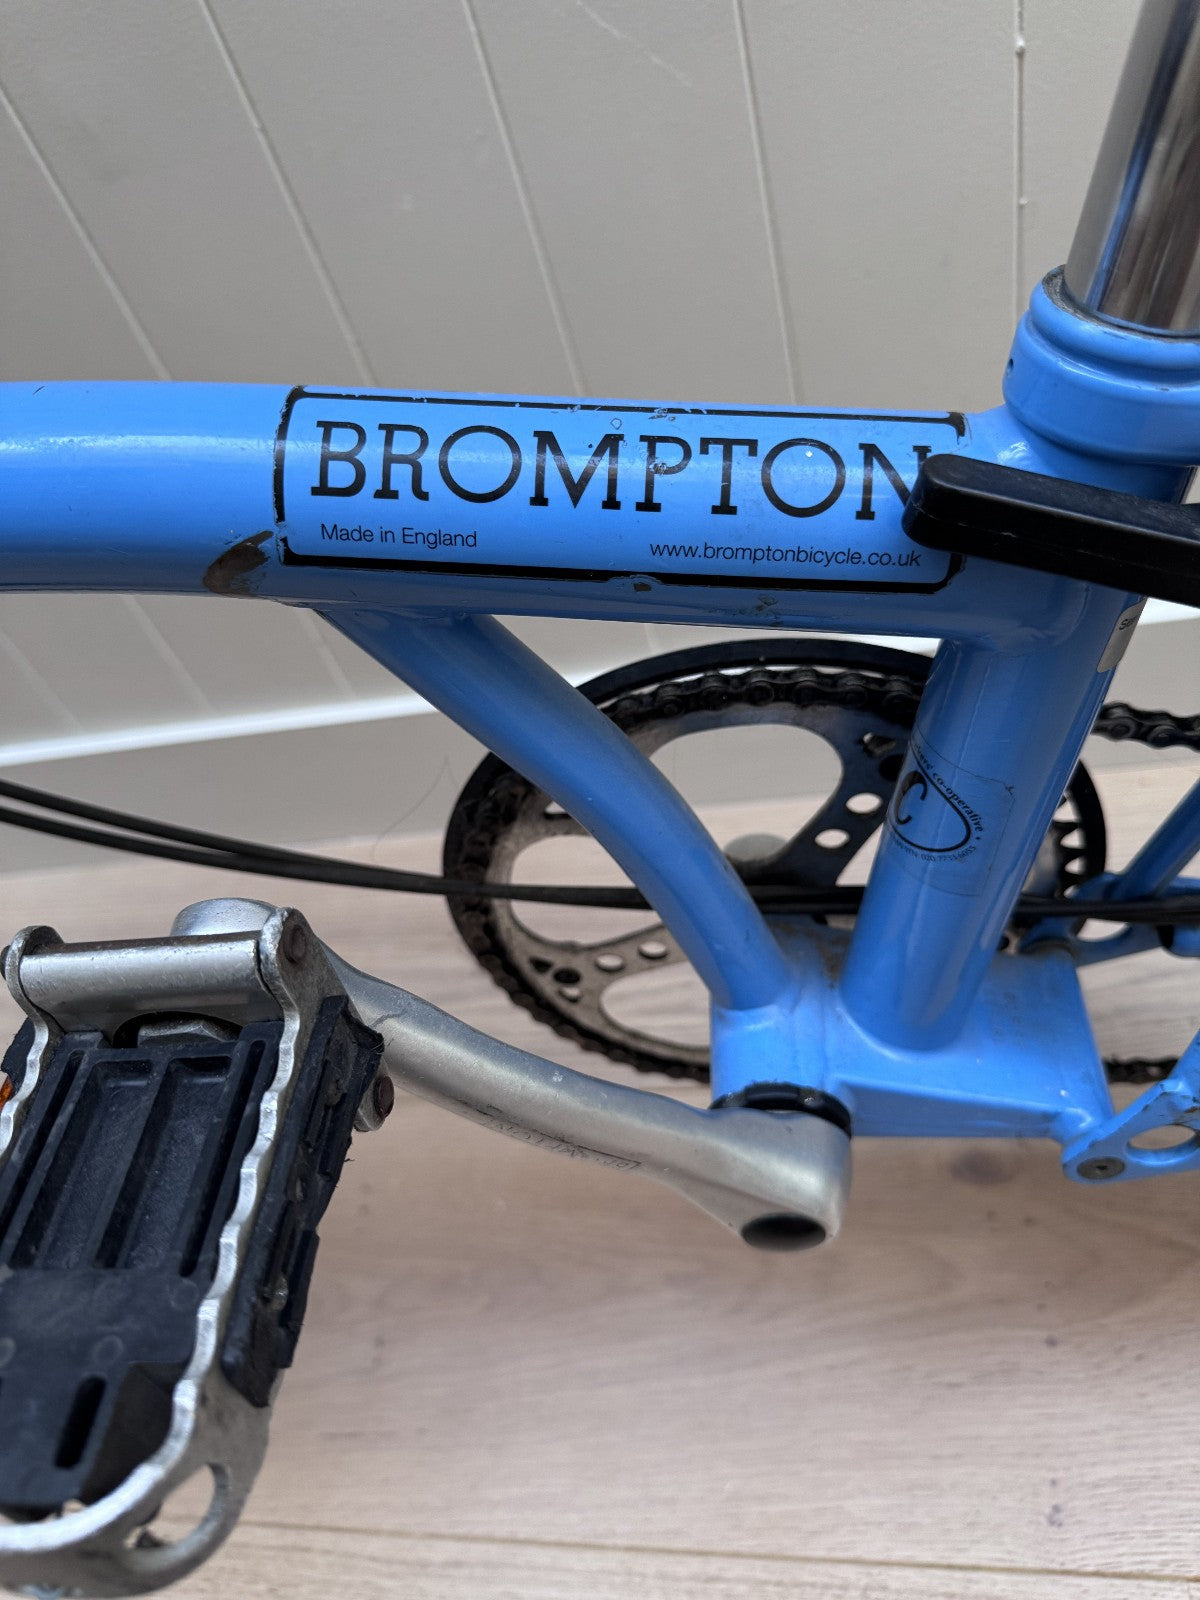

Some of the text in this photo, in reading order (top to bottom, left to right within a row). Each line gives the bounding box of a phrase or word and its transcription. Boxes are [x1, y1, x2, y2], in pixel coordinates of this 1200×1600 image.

[311, 420, 932, 521] BROMPTON
[321, 523, 477, 549] Made in England
[650, 542, 921, 568] www.bromptonbicycle.co.uk
